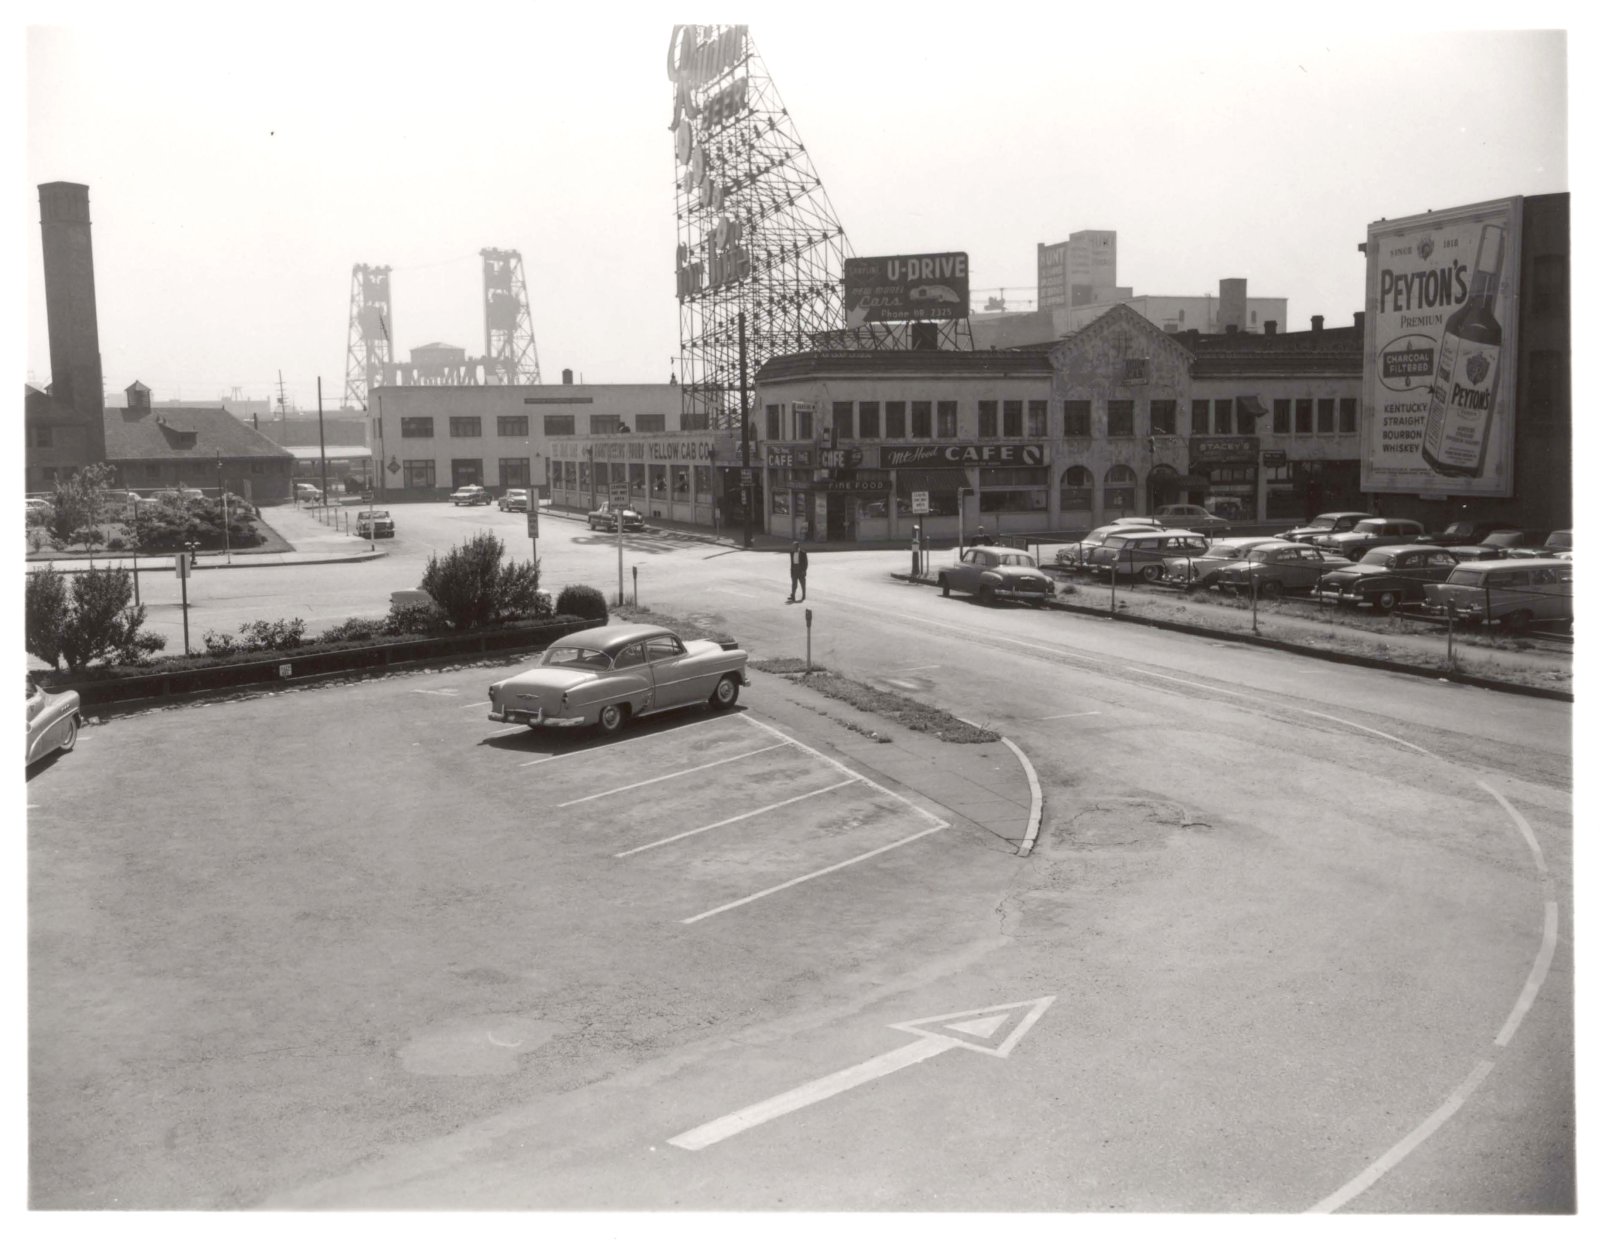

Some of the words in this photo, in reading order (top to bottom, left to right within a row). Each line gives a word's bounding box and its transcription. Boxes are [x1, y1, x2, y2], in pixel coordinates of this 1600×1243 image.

[887, 256, 966, 281] U-DRIVE
[1380, 259, 1468, 314] PEYTON'S
[860, 295, 904, 308] Cars
[1400, 315, 1443, 329] PREMIUM
[1386, 353, 1430, 364] CHARCOAL
[1389, 363, 1429, 373] FILTERED
[1451, 383, 1491, 410] PEYTON'S
[1384, 403, 1427, 413] KENTUCKY
[1383, 417, 1425, 426] STRAIGHT
[1382, 430, 1422, 440] BOURBON
[649, 442, 679, 460] YELLOW
[681, 442, 697, 460] CAB
[945, 446, 1014, 461] CAFE
[1382, 444, 1419, 453] WHISKEY
[768, 455, 793, 468] CAFE
[822, 450, 845, 468] CAFE
